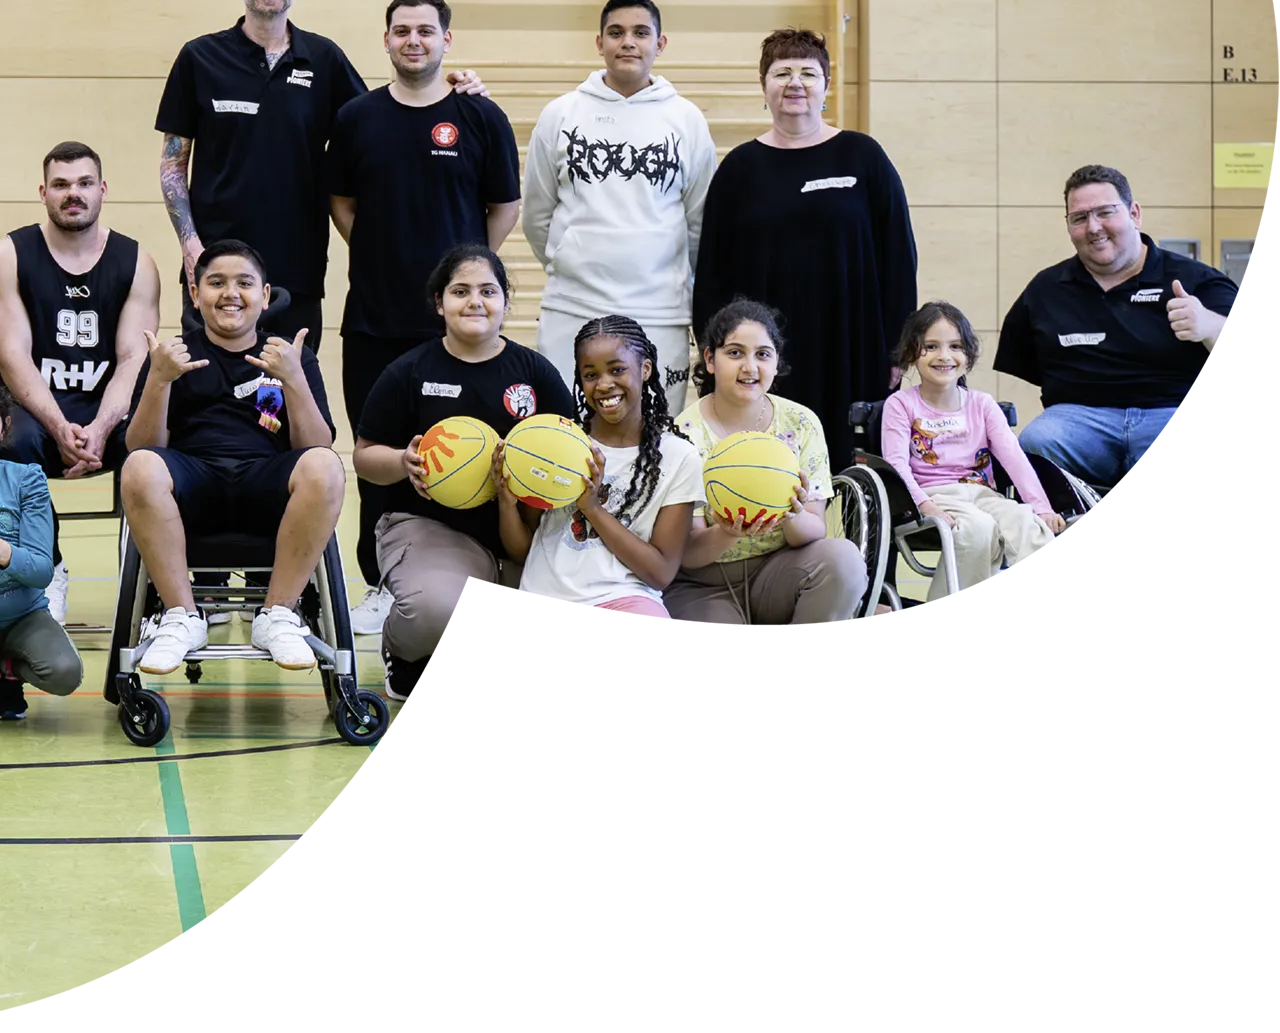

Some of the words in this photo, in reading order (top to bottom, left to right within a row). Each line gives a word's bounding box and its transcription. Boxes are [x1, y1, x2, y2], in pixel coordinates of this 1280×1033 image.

[1224, 45, 1234, 58] B
[1224, 67, 1257, 83] E.13
[562, 126, 681, 196] ROUGH
[56, 309, 99, 347] 99
[40, 357, 110, 391] R+V
